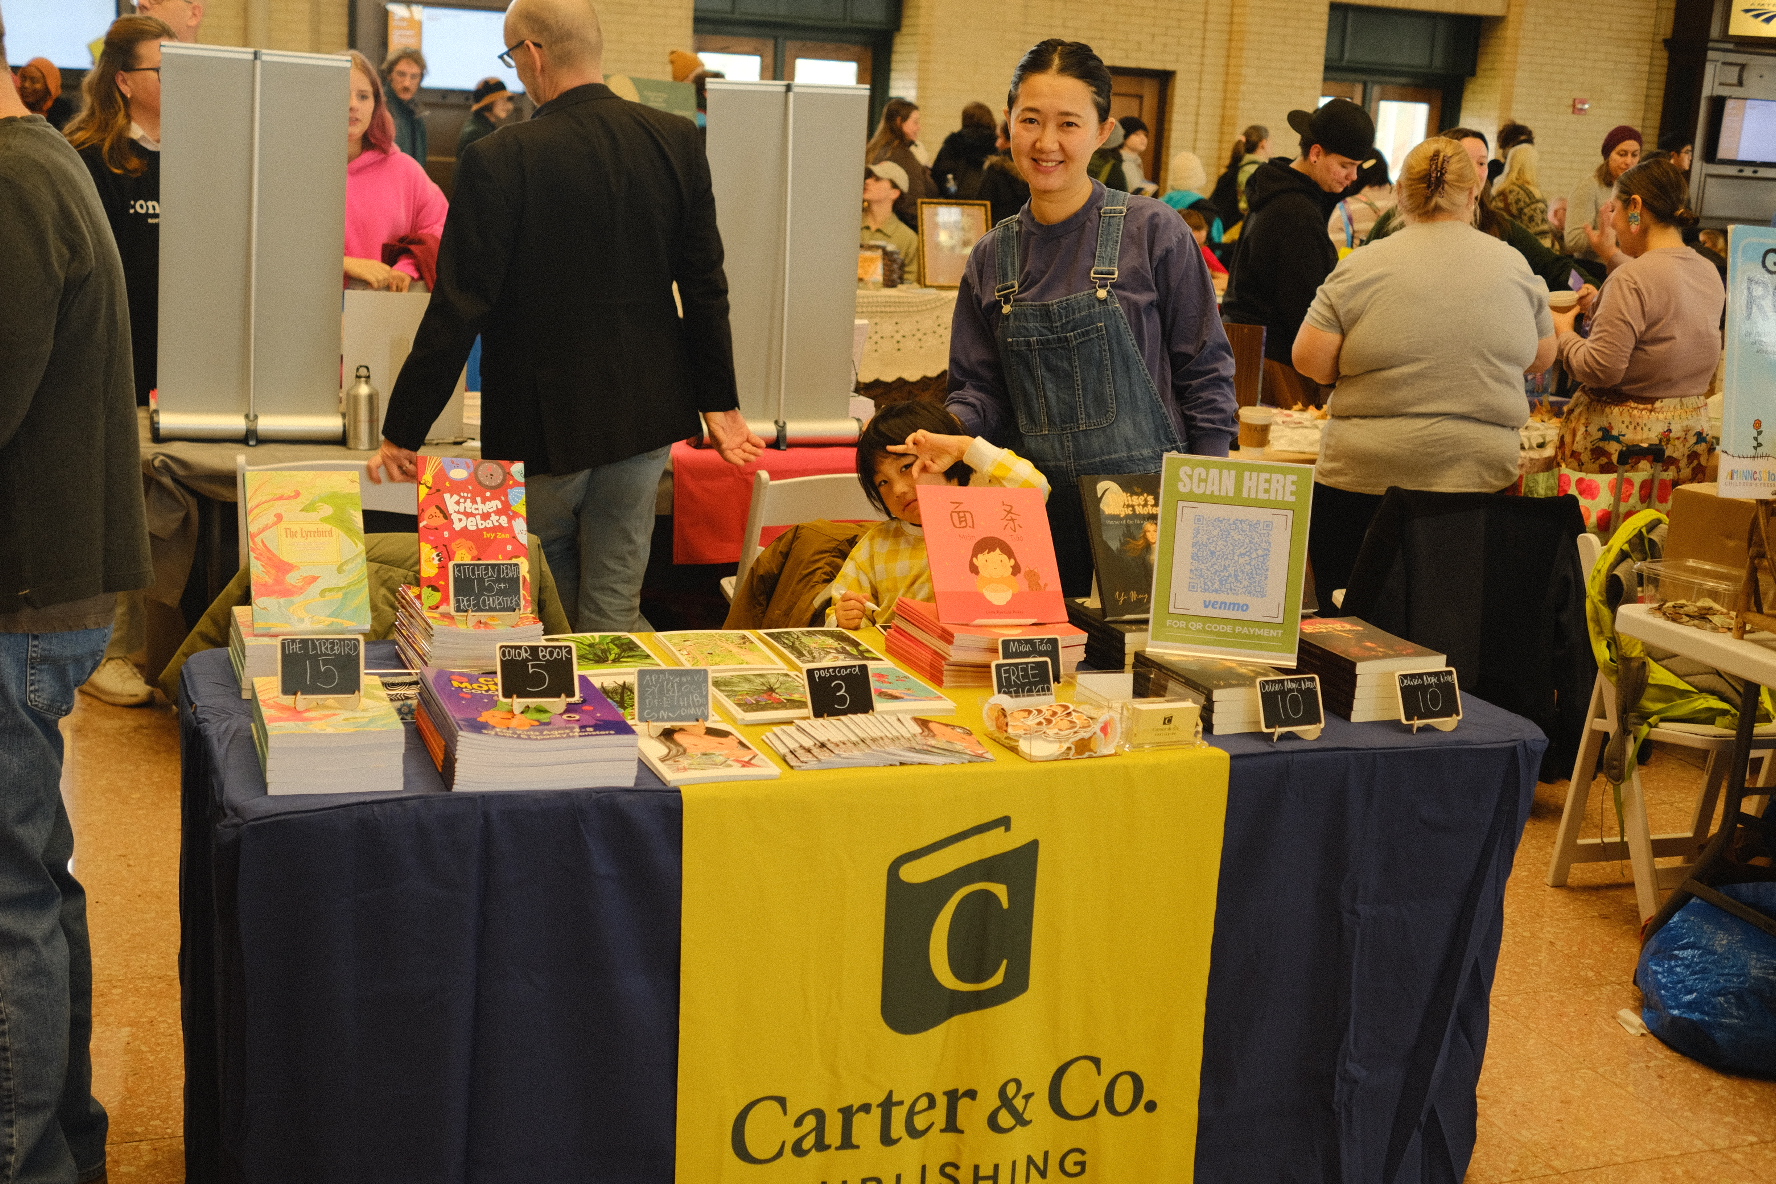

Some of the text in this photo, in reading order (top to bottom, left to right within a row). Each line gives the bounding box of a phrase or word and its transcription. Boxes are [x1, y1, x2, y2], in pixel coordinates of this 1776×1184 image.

[1177, 466, 1298, 502] SCAN HERE
[443, 492, 502, 515] Kitchen
[450, 512, 509, 531] Debate
[284, 526, 335, 541] The Lyrebird
[483, 531, 496, 540] Ivy
[454, 564, 498, 579] KITCHEN
[454, 596, 478, 611] FREE
[1203, 599, 1250, 613] venmo
[1166, 619, 1284, 638] FOR QR CODE PAYMENT
[281, 639, 359, 656] THE LYREBIRD
[500, 646, 571, 661] COLOR BOOK
[306, 656, 339, 689] 15
[526, 661, 549, 692] 5
[814, 665, 861, 682] postcard
[1001, 663, 1040, 686] FREE
[831, 680, 850, 709] 3
[1418, 688, 1442, 713] 10
[1278, 692, 1303, 719] 10
[929, 881, 1009, 993] C
[731, 1055, 1158, 1165] Carter & Co.
